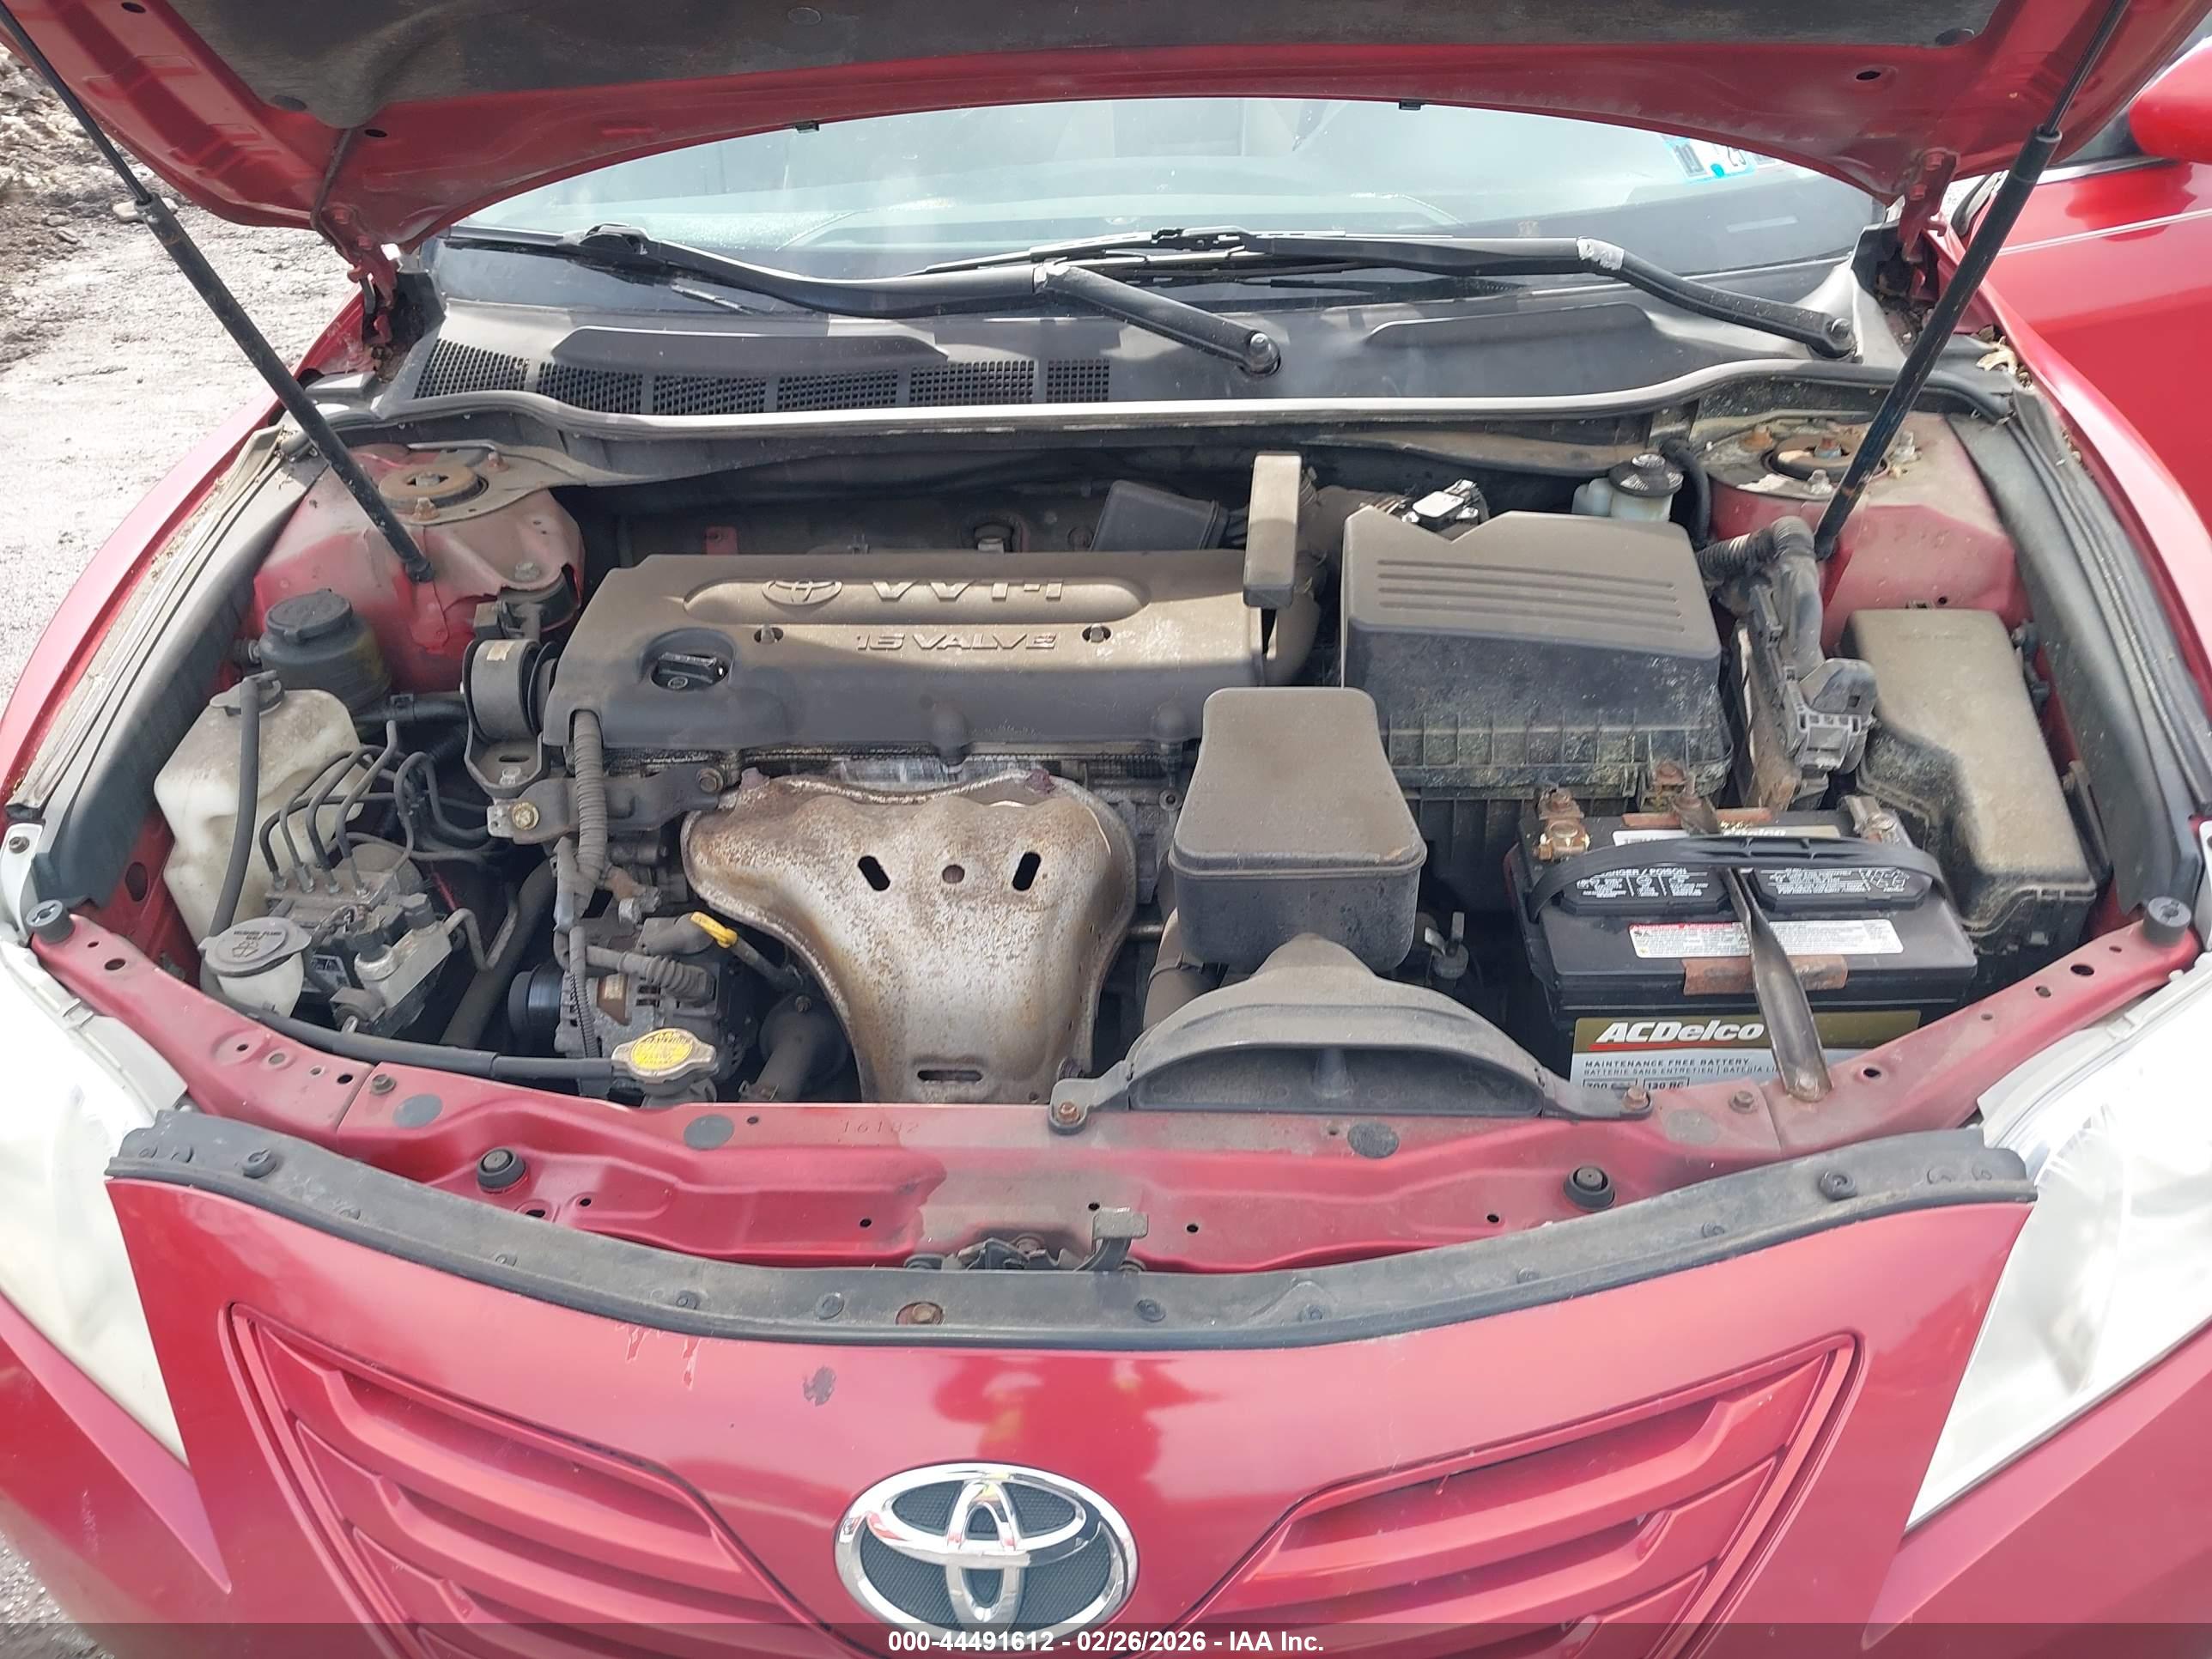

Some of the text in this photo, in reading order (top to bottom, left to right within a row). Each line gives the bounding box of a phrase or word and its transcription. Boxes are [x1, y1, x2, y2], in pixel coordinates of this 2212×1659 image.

[858, 632, 1057, 650] 16 VALVE
[1595, 1020, 1765, 1043] ACDelco
[1699, 1057, 1750, 1066] BATTERY
